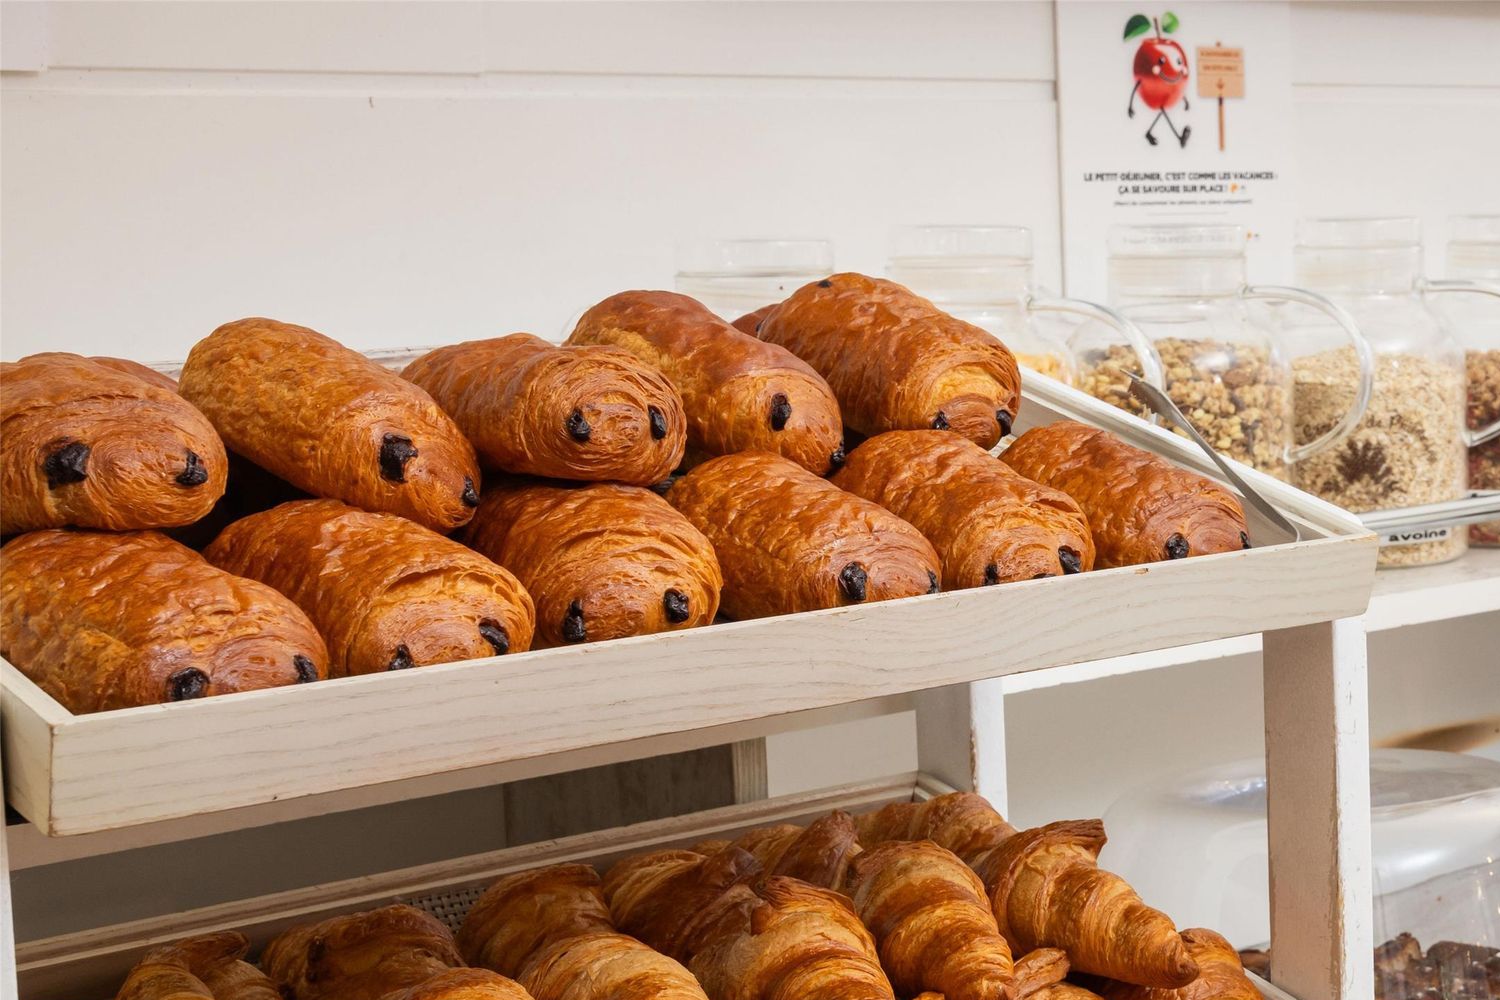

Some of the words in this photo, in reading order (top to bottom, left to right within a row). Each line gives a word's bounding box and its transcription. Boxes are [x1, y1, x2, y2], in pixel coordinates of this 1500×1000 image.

[1084, 173, 1093, 182] LE
[1188, 172, 1216, 181] COMME
[1218, 172, 1231, 180] LES
[1233, 171, 1274, 181] VACANCES
[1132, 185, 1140, 194] SE
[1143, 185, 1180, 194] SAVOURE
[1183, 185, 1198, 193] SUR
[1388, 528, 1448, 543] avoine
